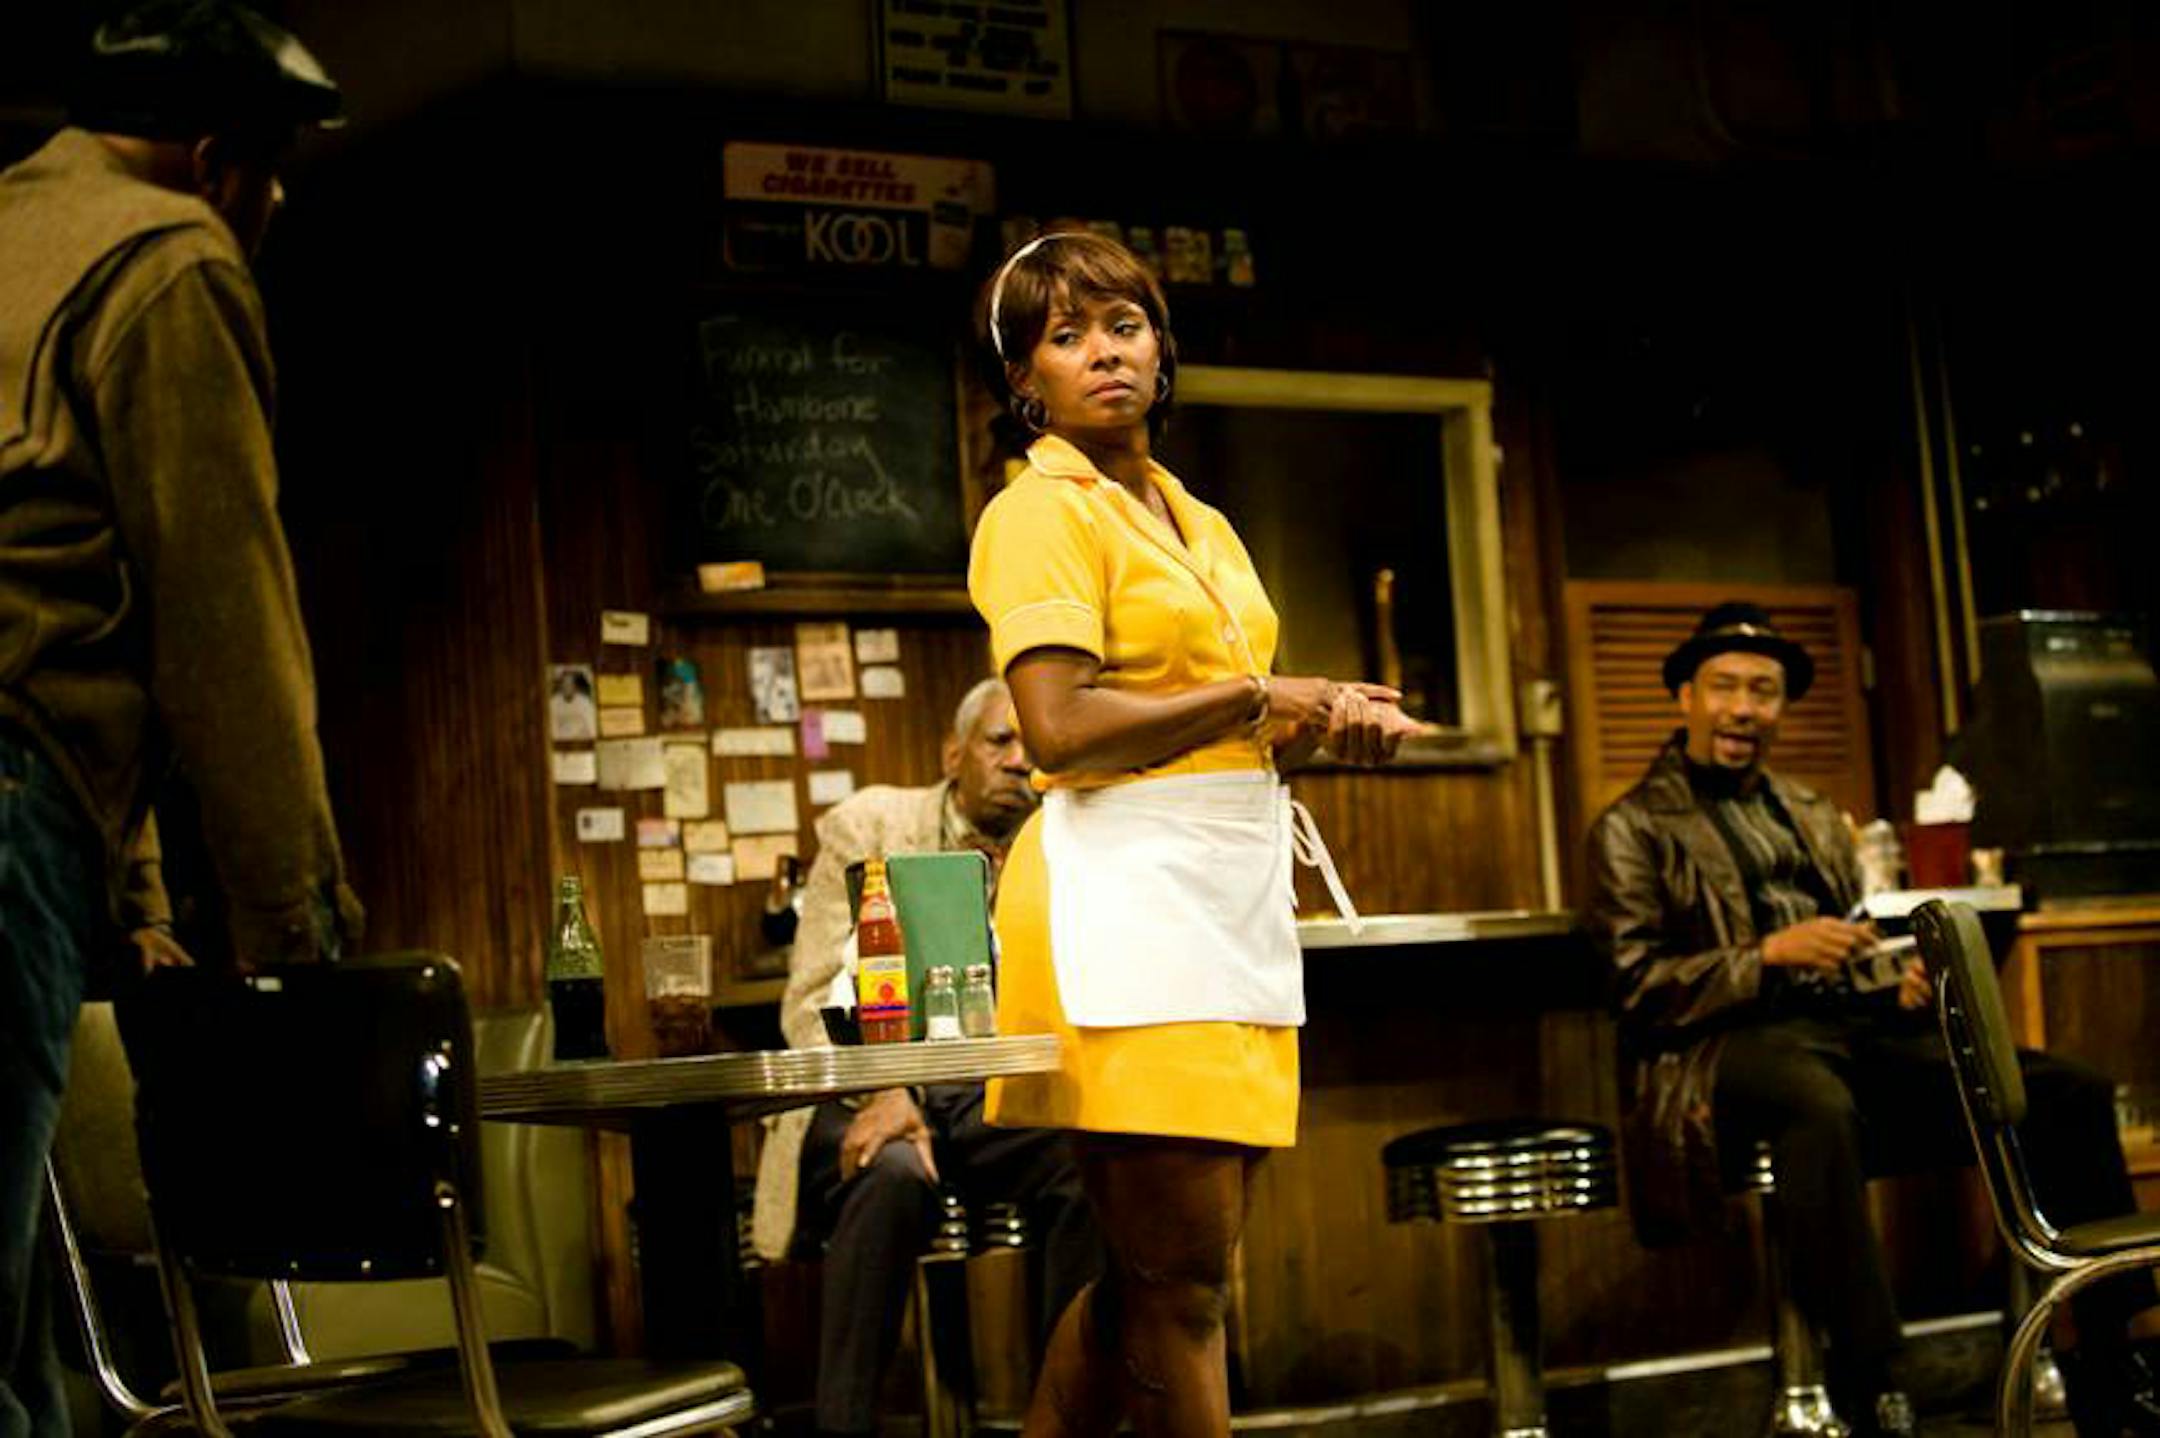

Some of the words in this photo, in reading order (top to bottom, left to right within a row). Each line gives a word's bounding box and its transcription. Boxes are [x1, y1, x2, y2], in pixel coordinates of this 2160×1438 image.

[838, 157, 895, 179] SELL
[803, 207, 921, 267] KOOL
[733, 380, 880, 426] Hambone
[690, 424, 887, 492] Saturday
[702, 475, 777, 529] One
